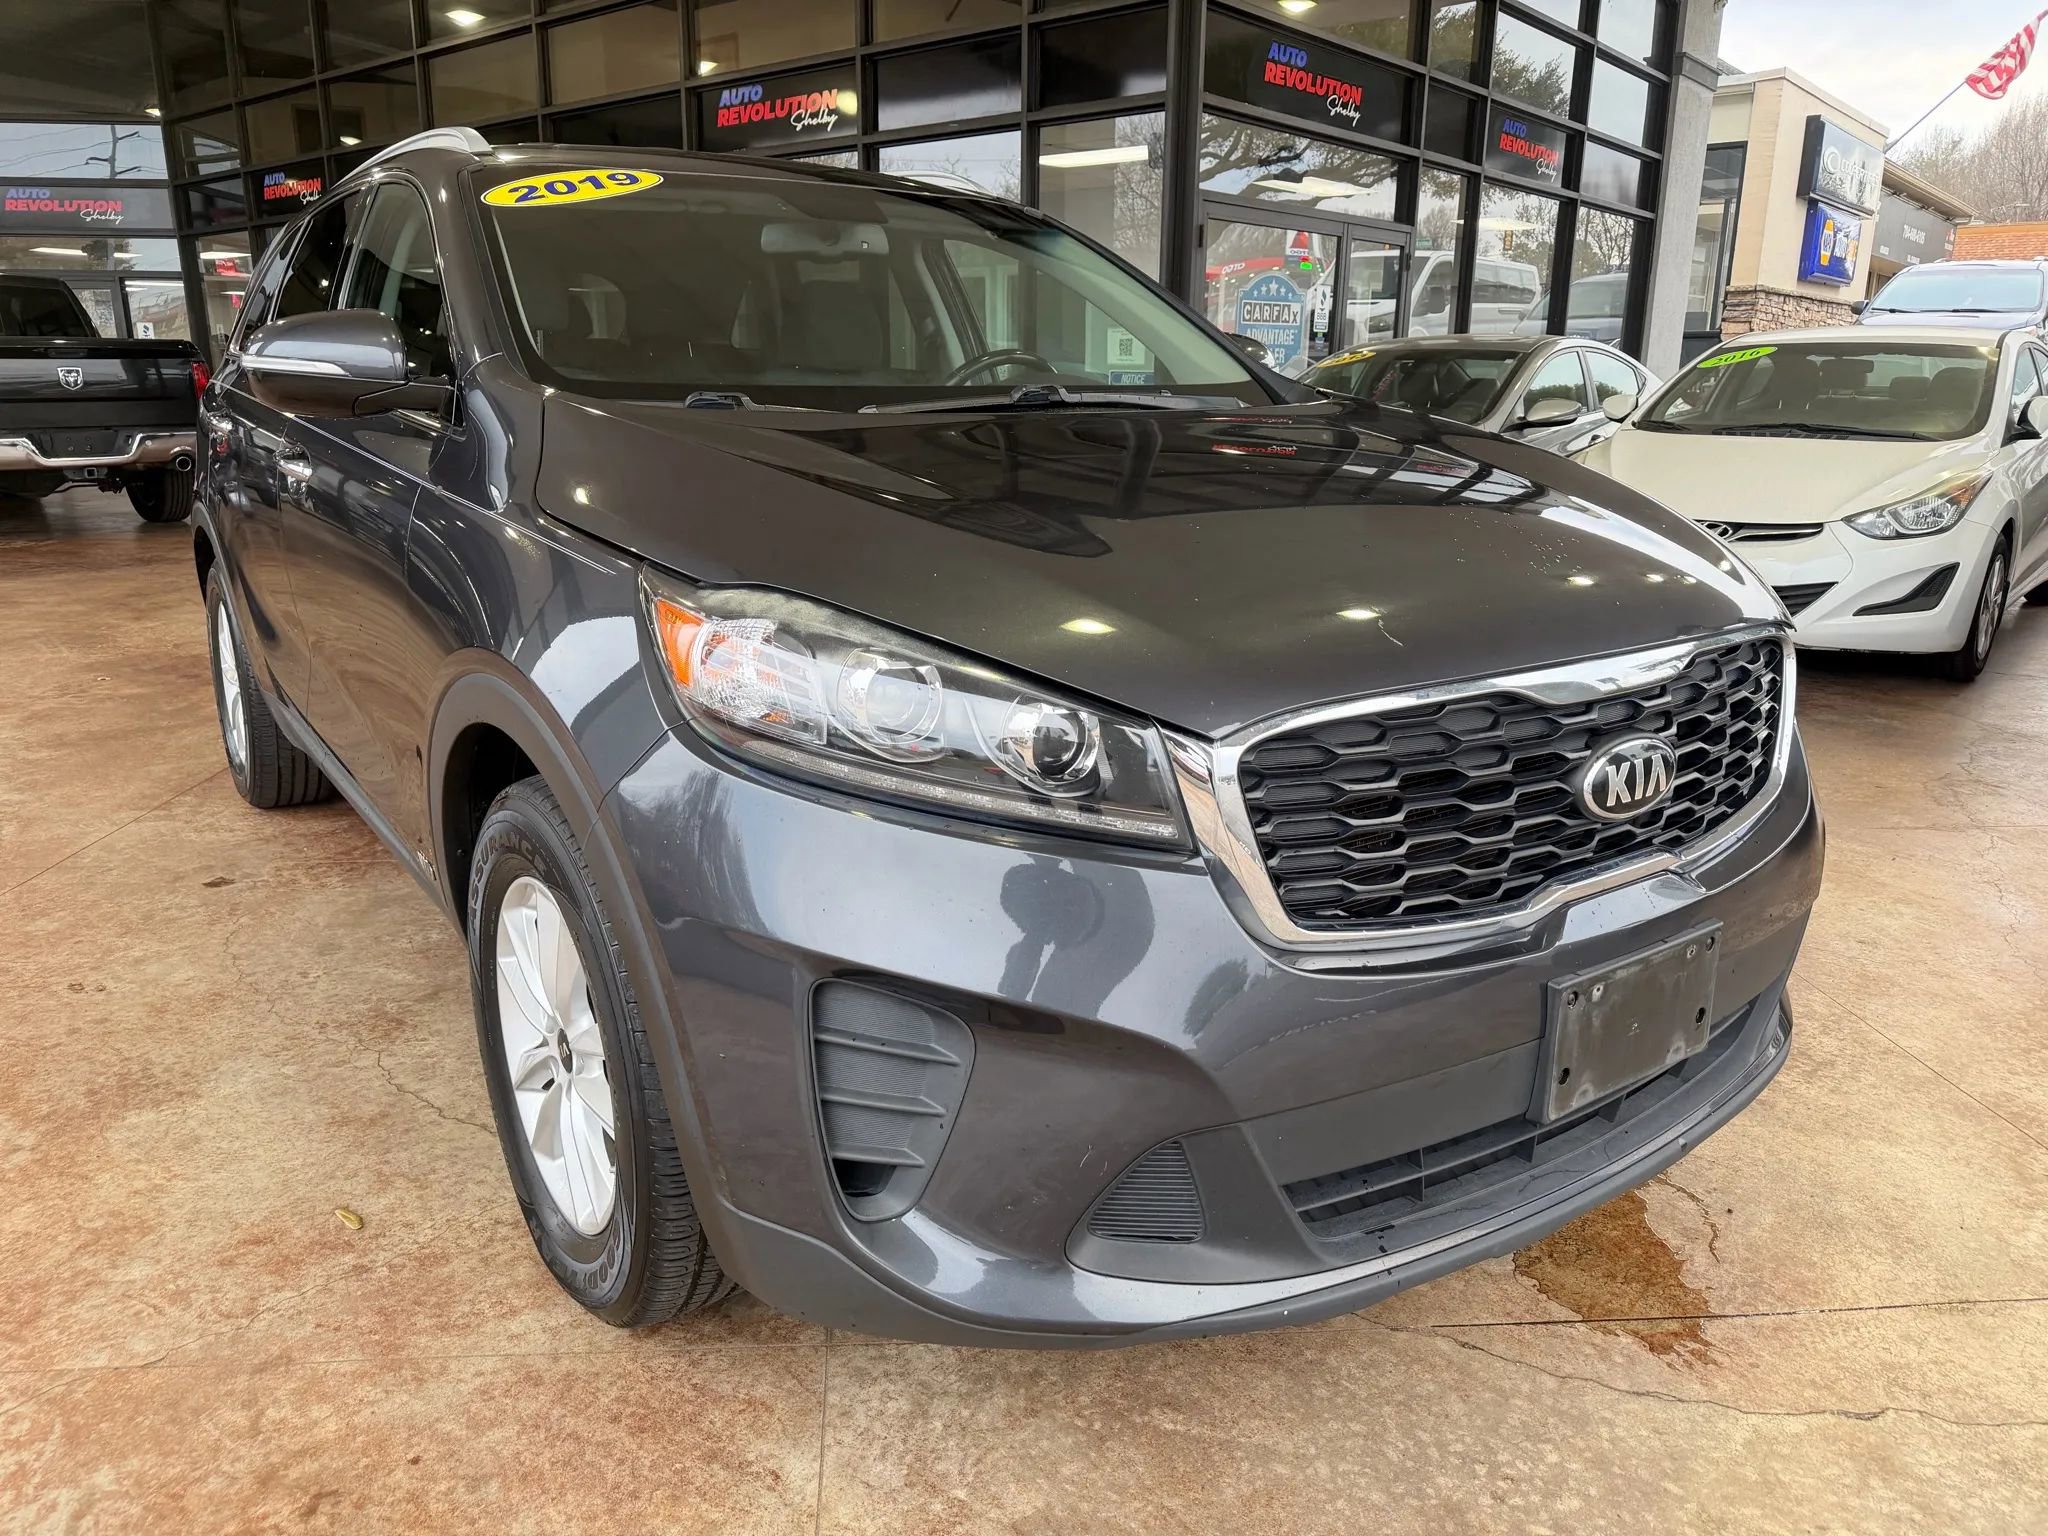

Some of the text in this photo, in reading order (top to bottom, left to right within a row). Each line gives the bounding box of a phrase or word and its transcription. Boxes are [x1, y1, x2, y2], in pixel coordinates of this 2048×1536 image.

[1267, 41, 1308, 68] AUTO
[720, 84, 763, 107] AUTO
[1264, 61, 1363, 106] REVOLUTION
[717, 88, 838, 128] REVOLUTION
[790, 104, 838, 132] Shelby
[1326, 94, 1361, 127] Shelby
[1503, 118, 1527, 138] AUTO
[1499, 132, 1560, 167] REVOLUTION
[264, 171, 286, 187] AUTO
[1536, 158, 1557, 183] Shelby
[6, 188, 50, 198] AUTO
[264, 177, 321, 200] REVOLUTION
[508, 172, 641, 203] 2019
[5, 199, 124, 212] REVOLUTION
[79, 208, 124, 224] Shelby
[1243, 303, 1300, 324] CARFAX
[1711, 350, 1761, 366] 2016
[1120, 374, 1146, 384] NOTICE
[1605, 753, 1667, 807] KIA
[467, 832, 548, 937] ASSURANCE
